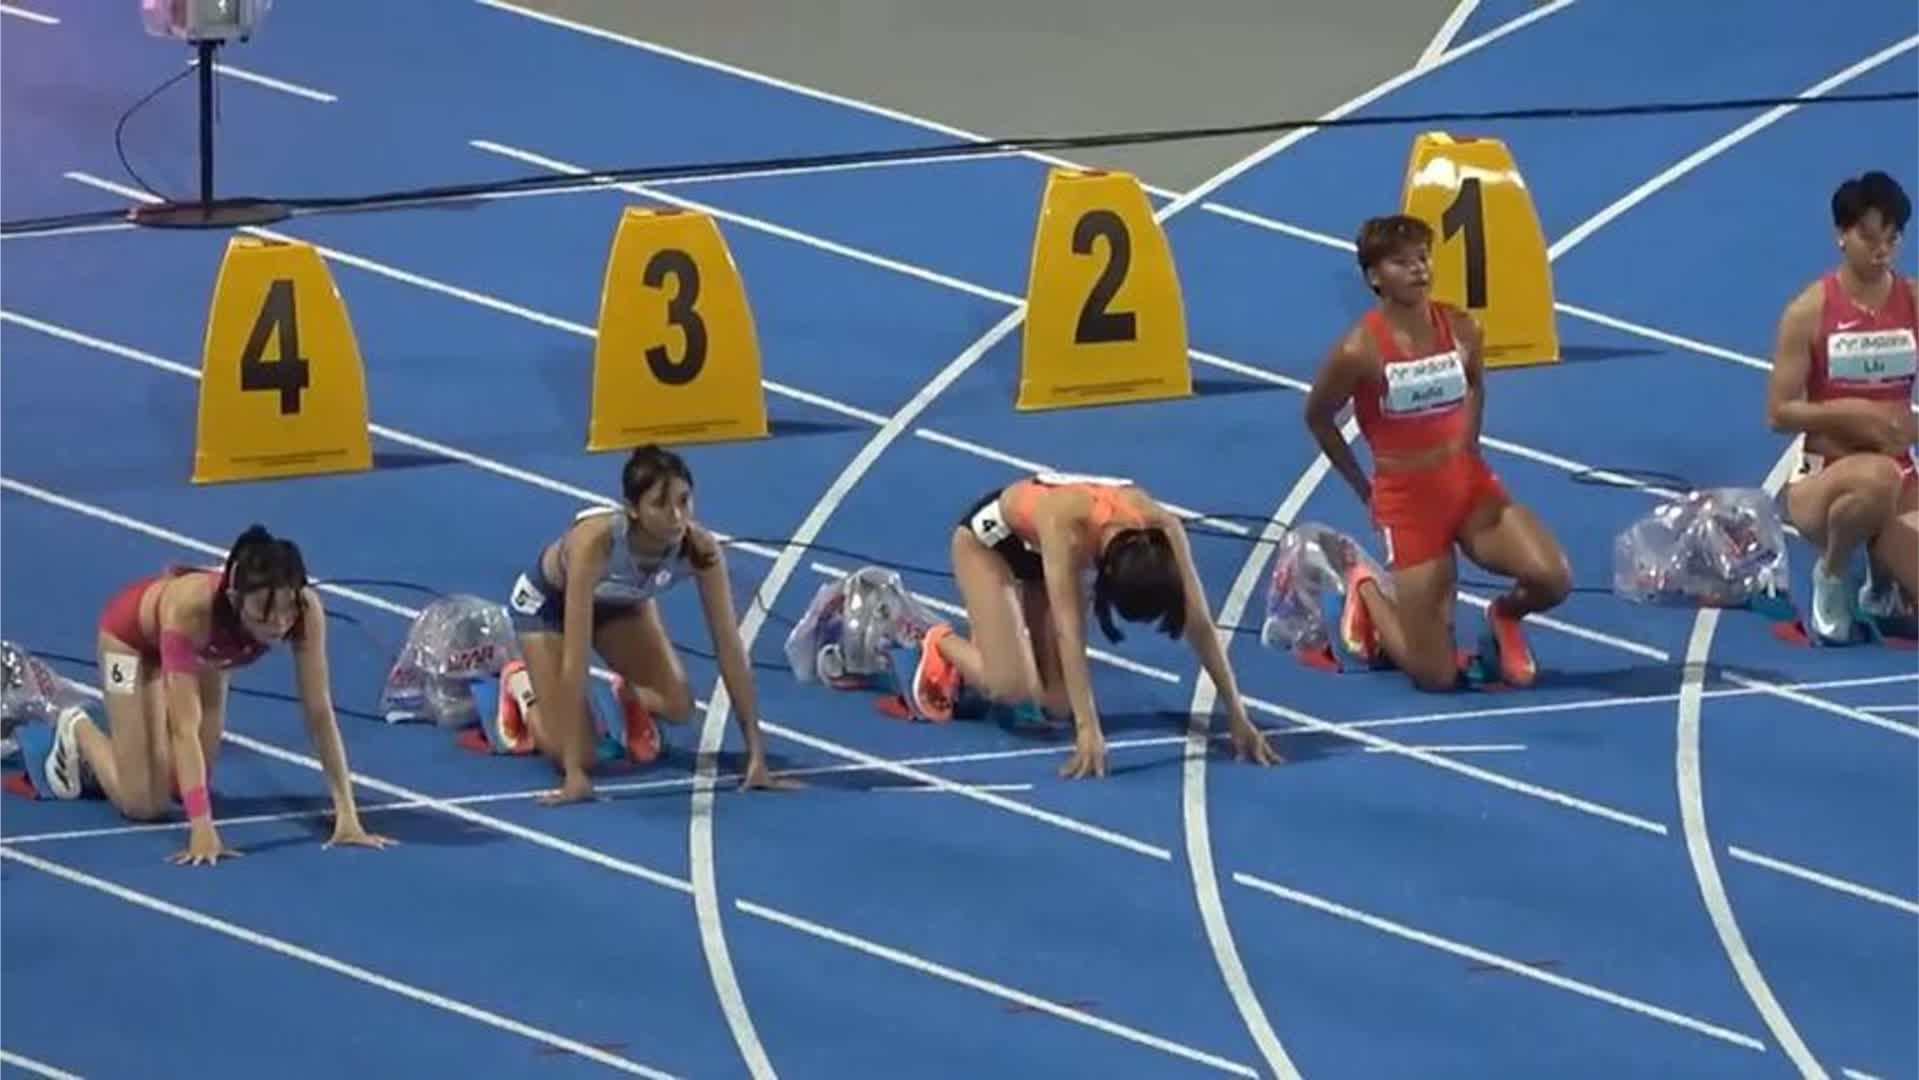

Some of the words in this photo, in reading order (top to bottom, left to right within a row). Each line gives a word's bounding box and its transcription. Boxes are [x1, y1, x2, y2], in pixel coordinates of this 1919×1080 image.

[1072, 210, 1138, 346] 2
[1442, 177, 1487, 309] 1
[240, 280, 310, 415] 4
[643, 249, 707, 386] 3
[111, 663, 124, 683] 6
